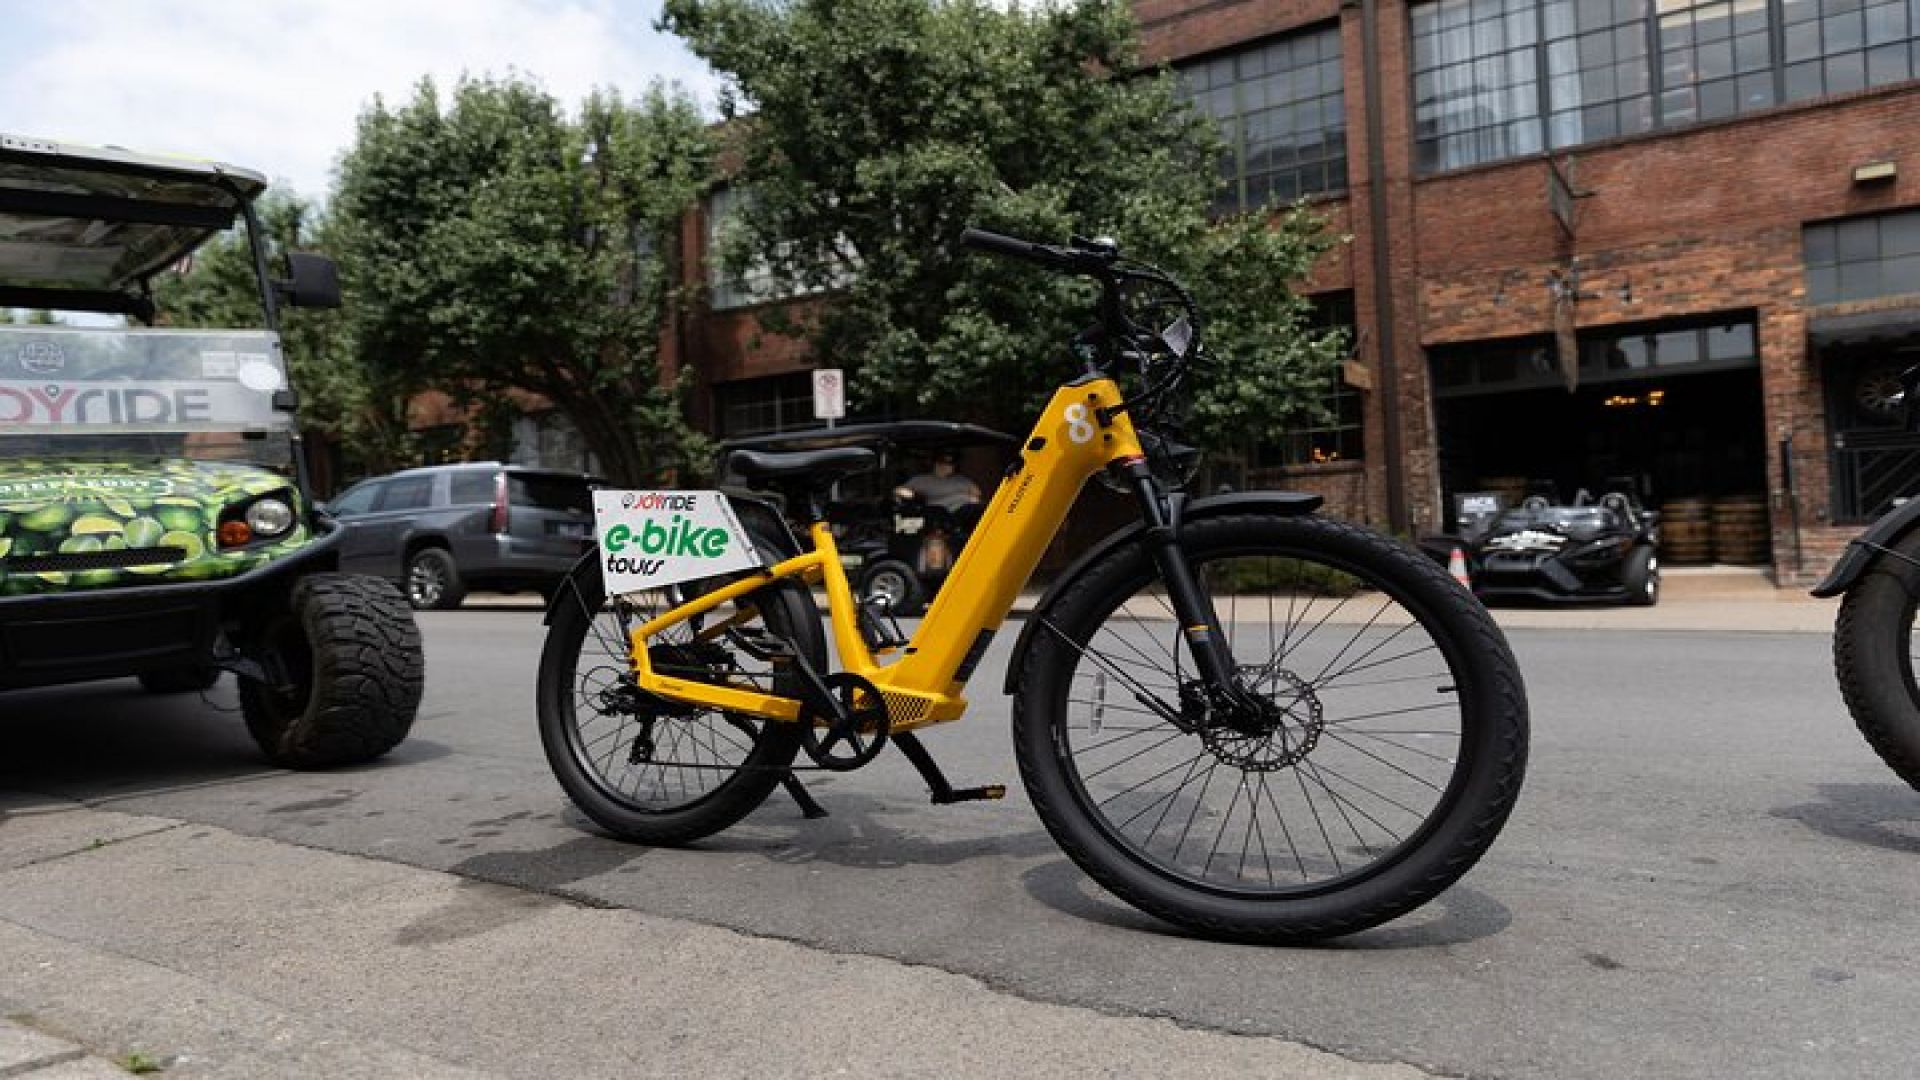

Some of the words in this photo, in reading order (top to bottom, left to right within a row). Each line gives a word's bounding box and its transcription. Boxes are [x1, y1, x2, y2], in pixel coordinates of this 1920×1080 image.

[1064, 403, 1094, 443] 8
[605, 514, 729, 558] e-bike
[607, 553, 665, 576] tours
